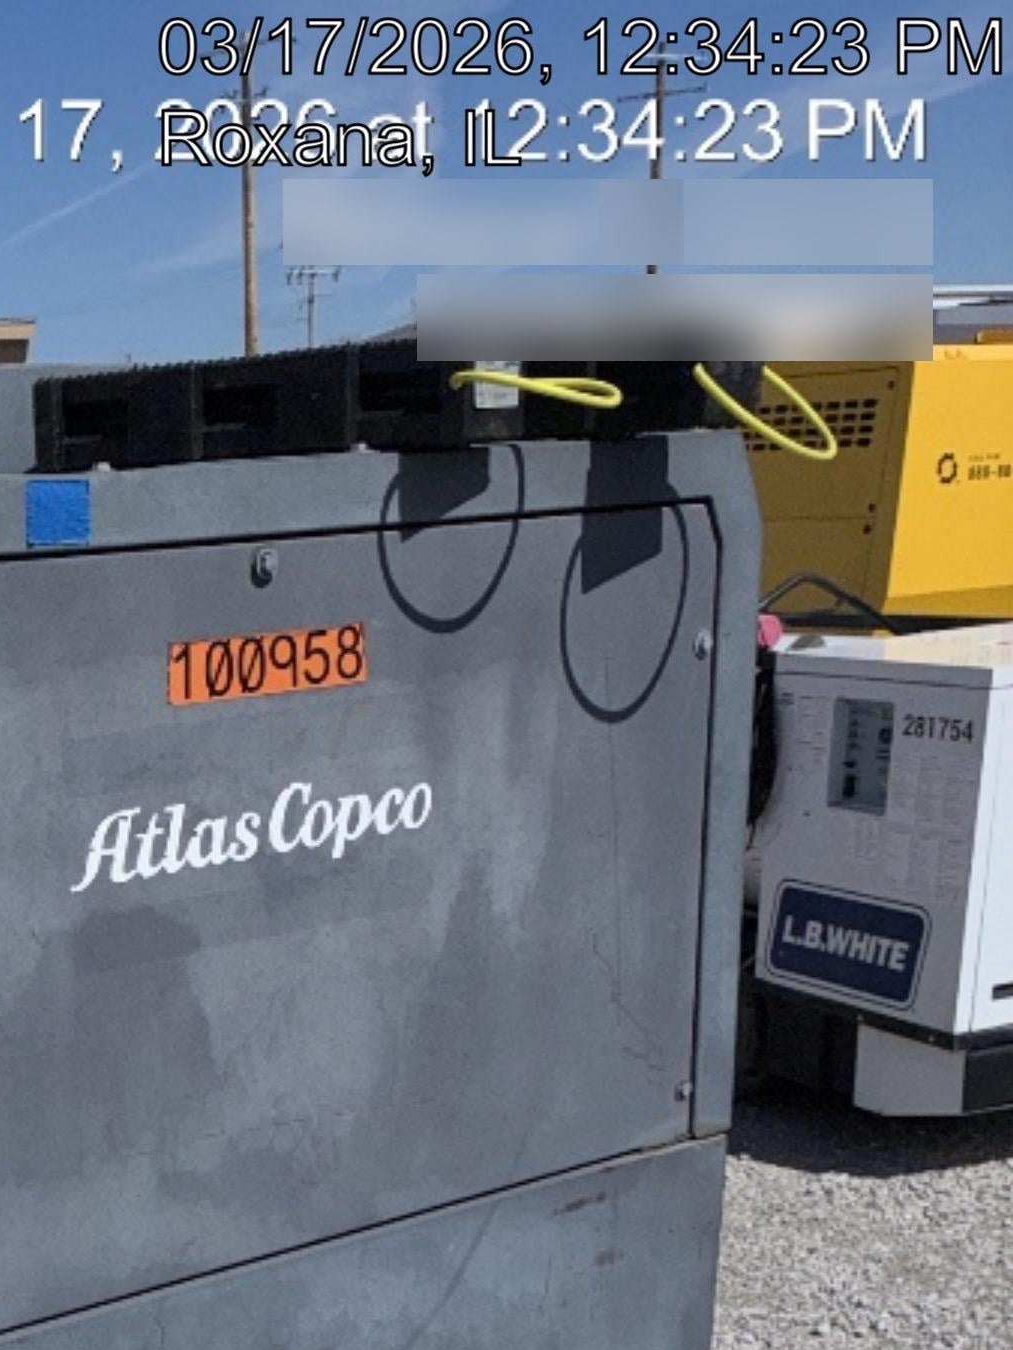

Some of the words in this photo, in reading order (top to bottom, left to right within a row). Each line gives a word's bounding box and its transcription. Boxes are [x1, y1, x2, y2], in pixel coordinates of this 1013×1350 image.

[173, 625, 364, 699] 100958
[902, 714, 974, 744] 281754
[69, 802, 262, 892] Atlas
[268, 782, 433, 859] Copco
